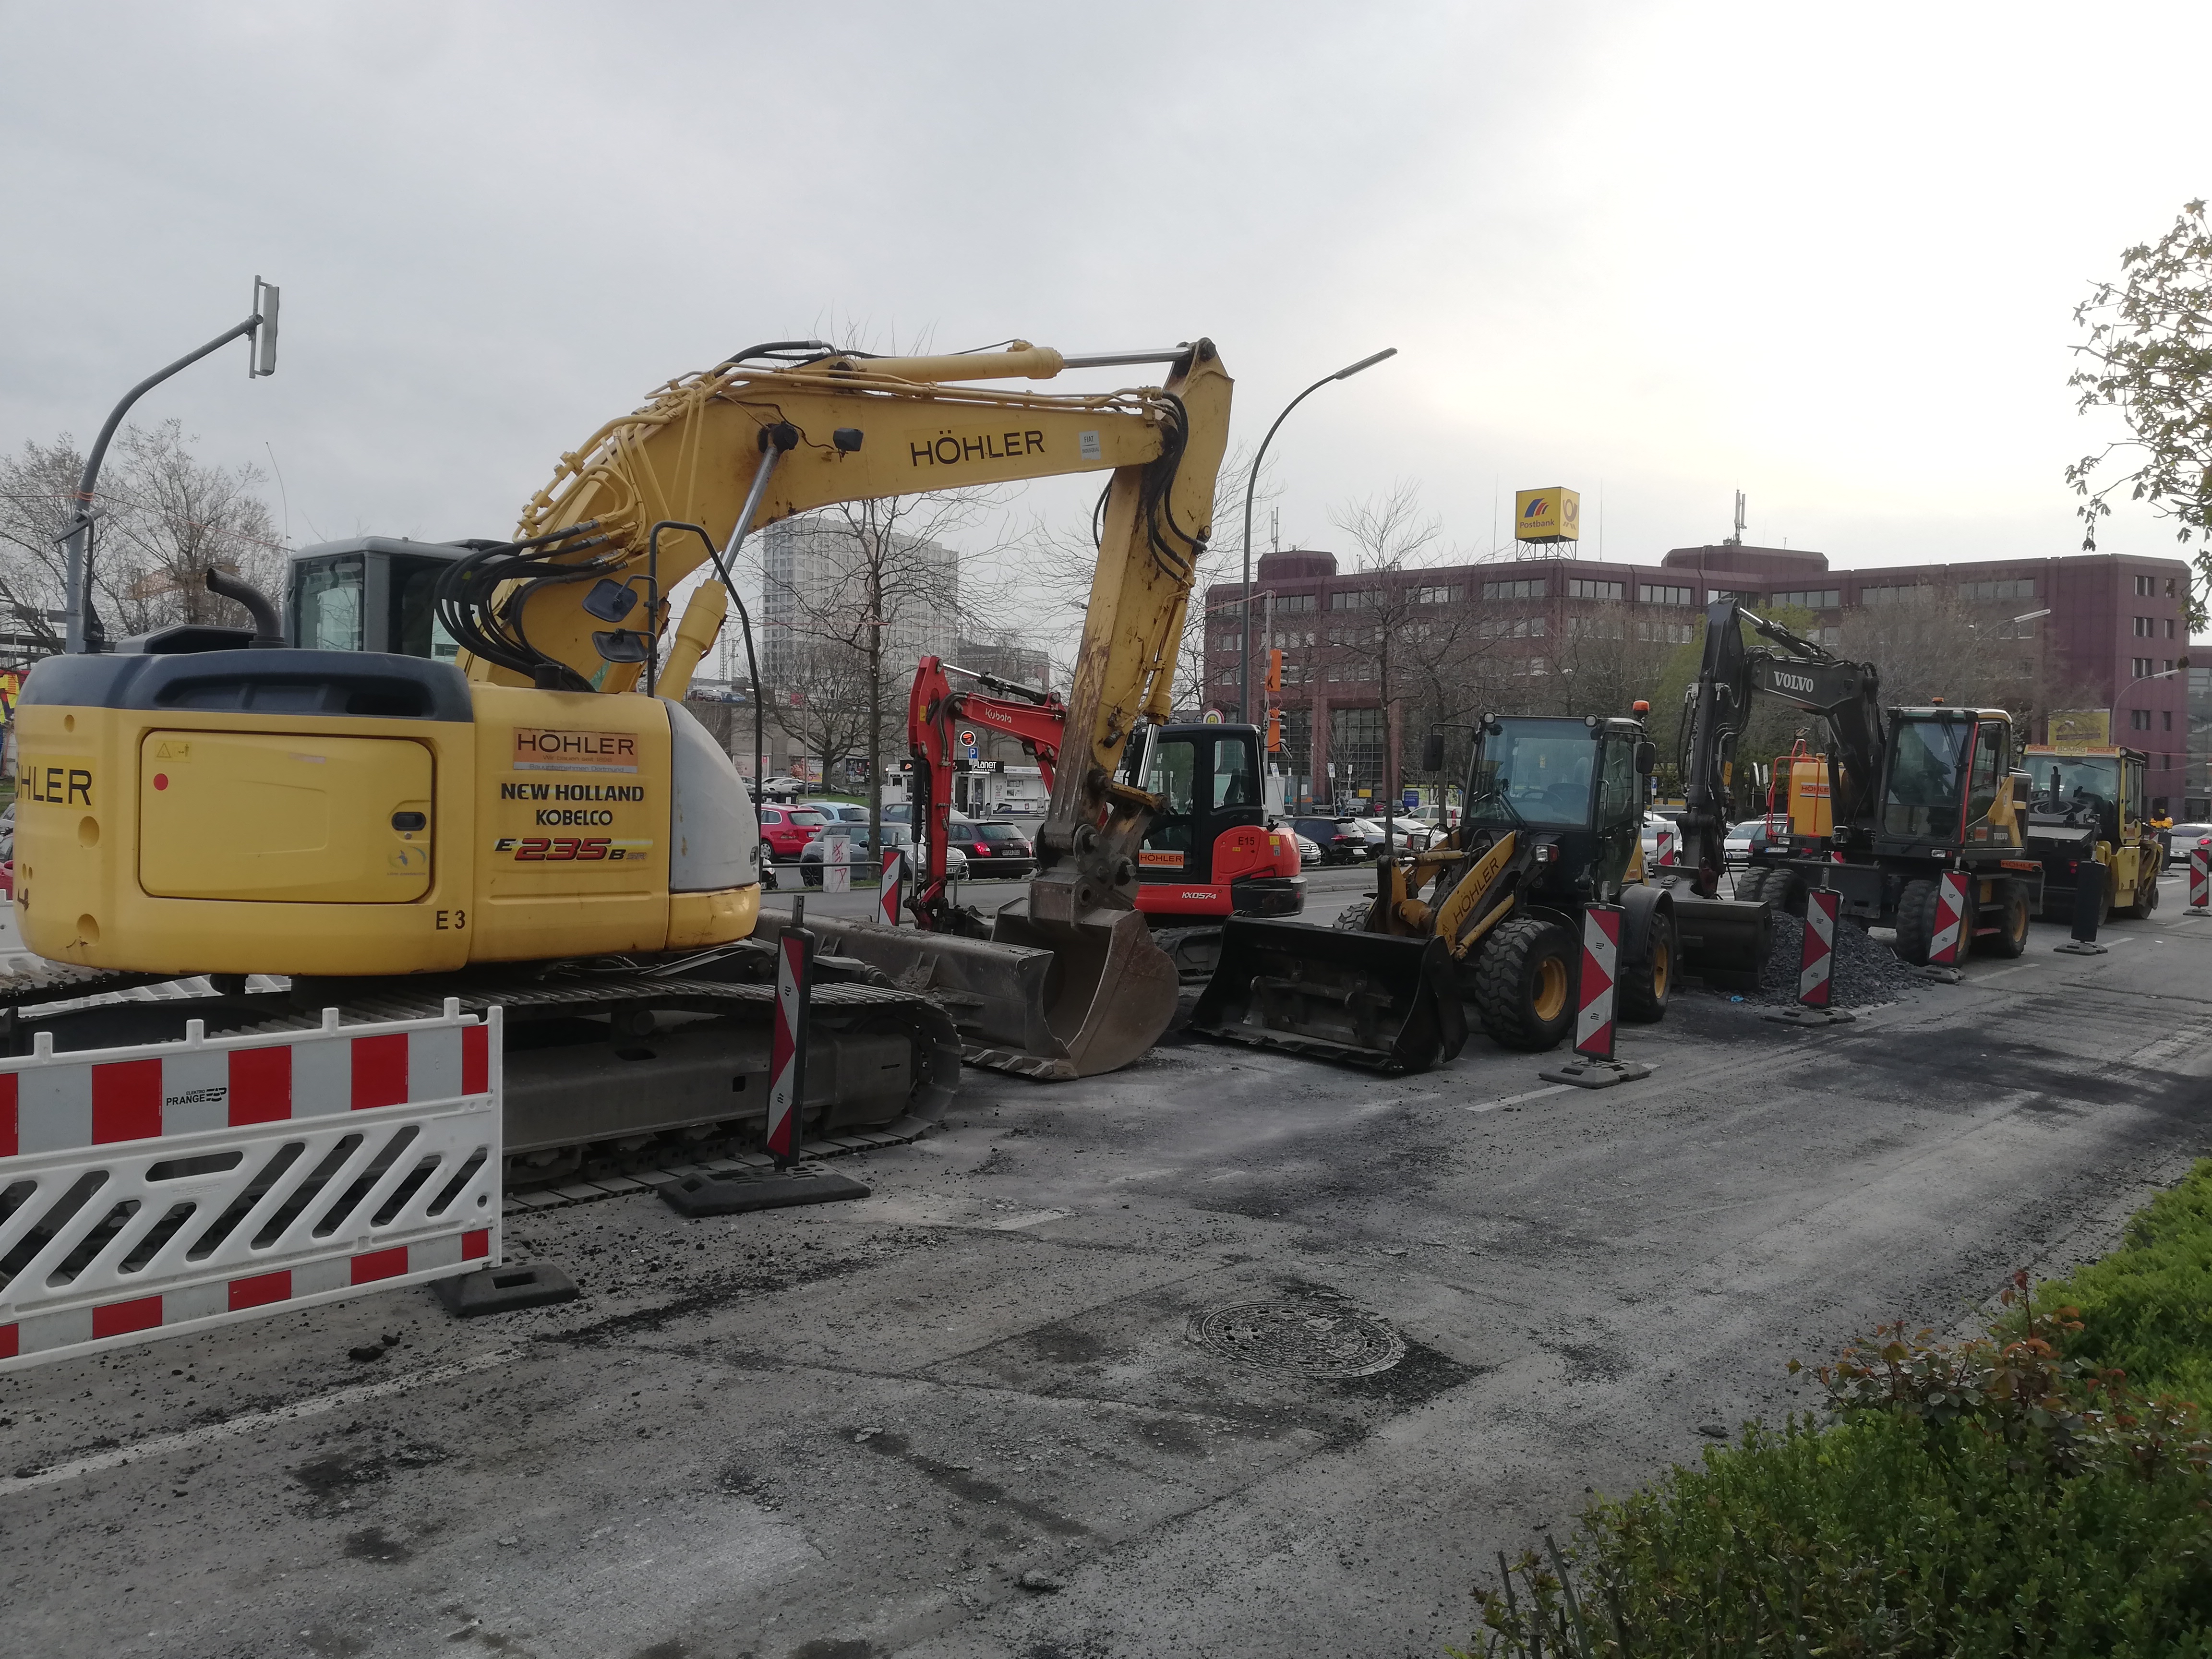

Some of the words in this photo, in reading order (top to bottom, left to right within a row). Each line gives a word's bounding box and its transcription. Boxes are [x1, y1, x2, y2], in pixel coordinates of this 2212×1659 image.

[910, 430, 1046, 467] HÖHLER
[1520, 518, 1555, 529] Postbank
[1773, 671, 1814, 693] VOLVO
[985, 708, 1012, 723] Kubota
[970, 748, 975, 758] P
[501, 783, 550, 800] NEW
[555, 784, 645, 802] HOLLAND
[536, 809, 613, 826] KOBELCO
[1238, 836, 1255, 846] E15
[1140, 853, 1183, 862] HÖHLER
[1453, 857, 1499, 925] HÖHLER
[166, 1094, 205, 1106] PRANGE
